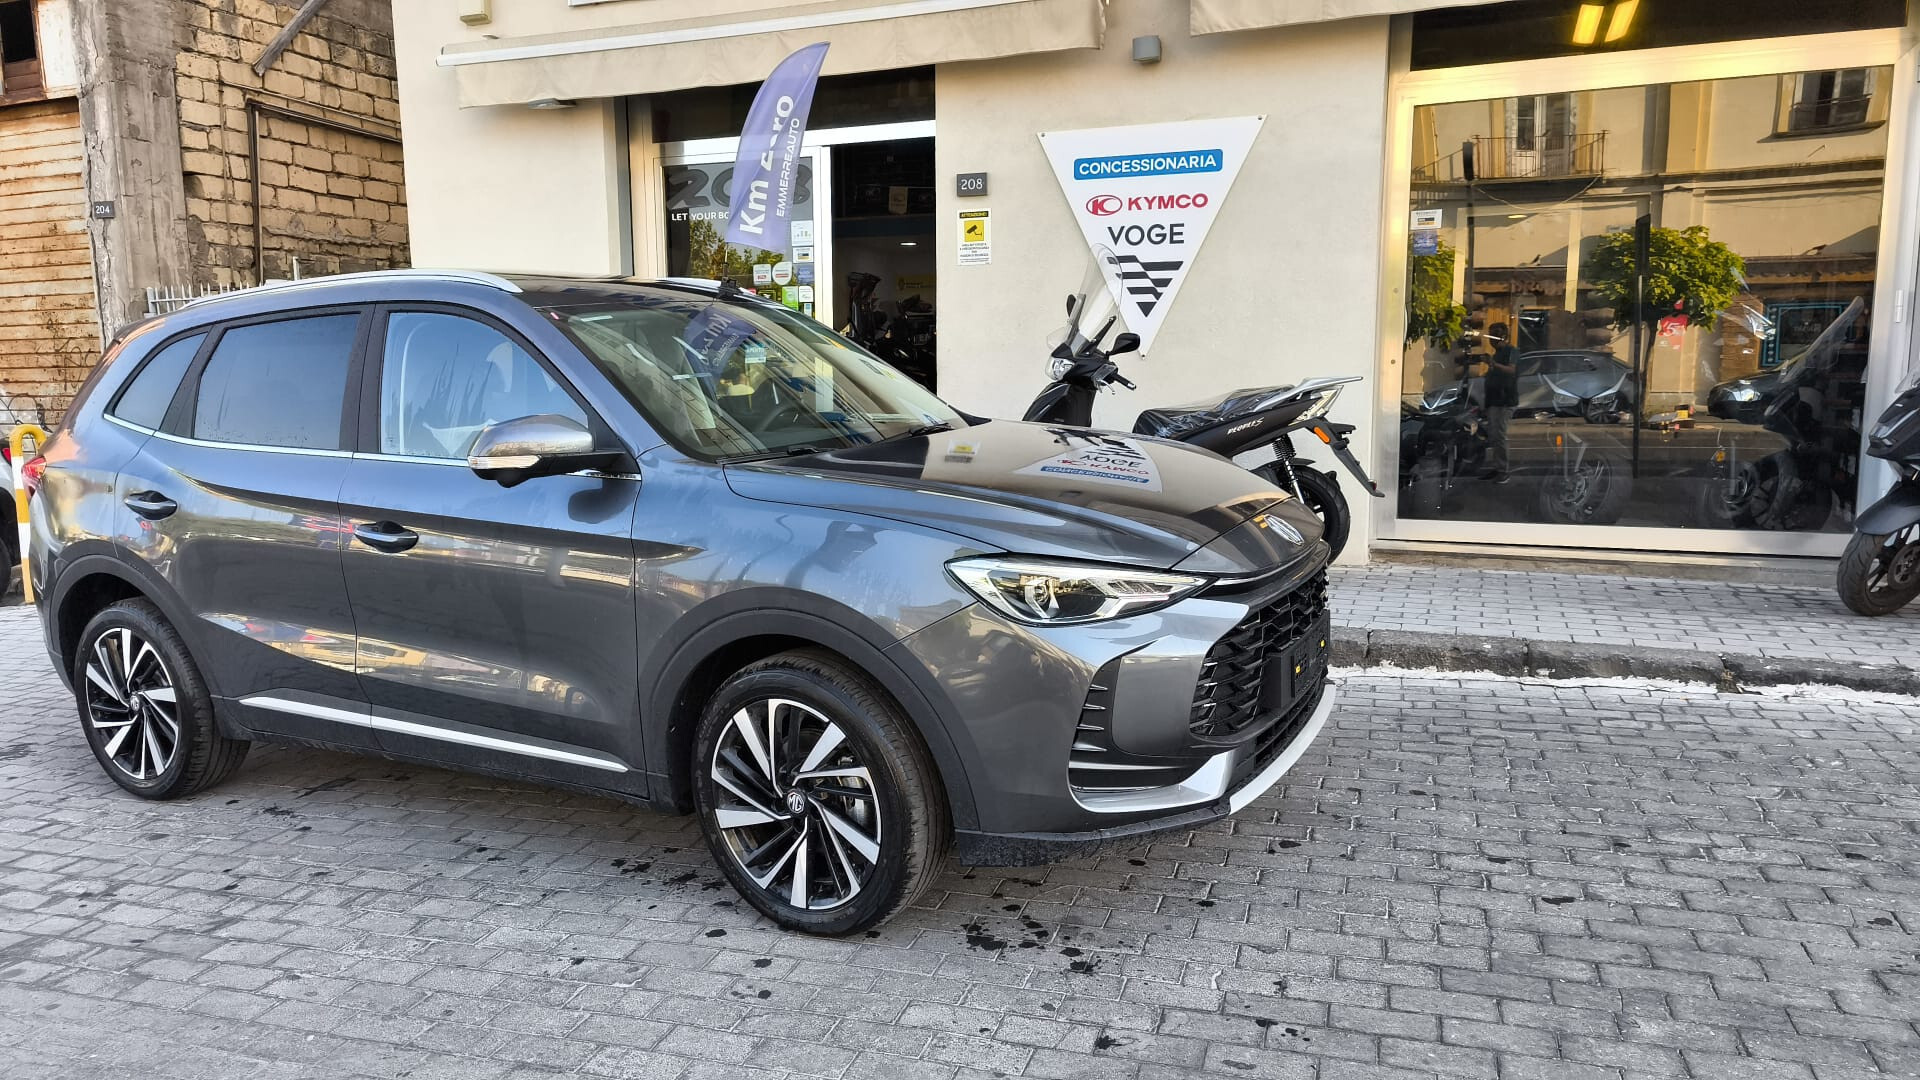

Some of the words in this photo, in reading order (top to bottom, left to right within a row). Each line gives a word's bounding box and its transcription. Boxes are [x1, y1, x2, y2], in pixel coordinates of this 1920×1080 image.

[776, 118, 800, 217] EMMERREAUTO
[1079, 154, 1217, 175] CONCESSIONARIA
[961, 178, 983, 190] 208
[95, 205, 110, 214] 204
[740, 180, 769, 235] Km
[1128, 193, 1209, 211] KYMCO
[671, 213, 688, 221] LET
[691, 212, 717, 220] YOUR
[1108, 223, 1185, 246] VOGE
[788, 793, 804, 813] MG
